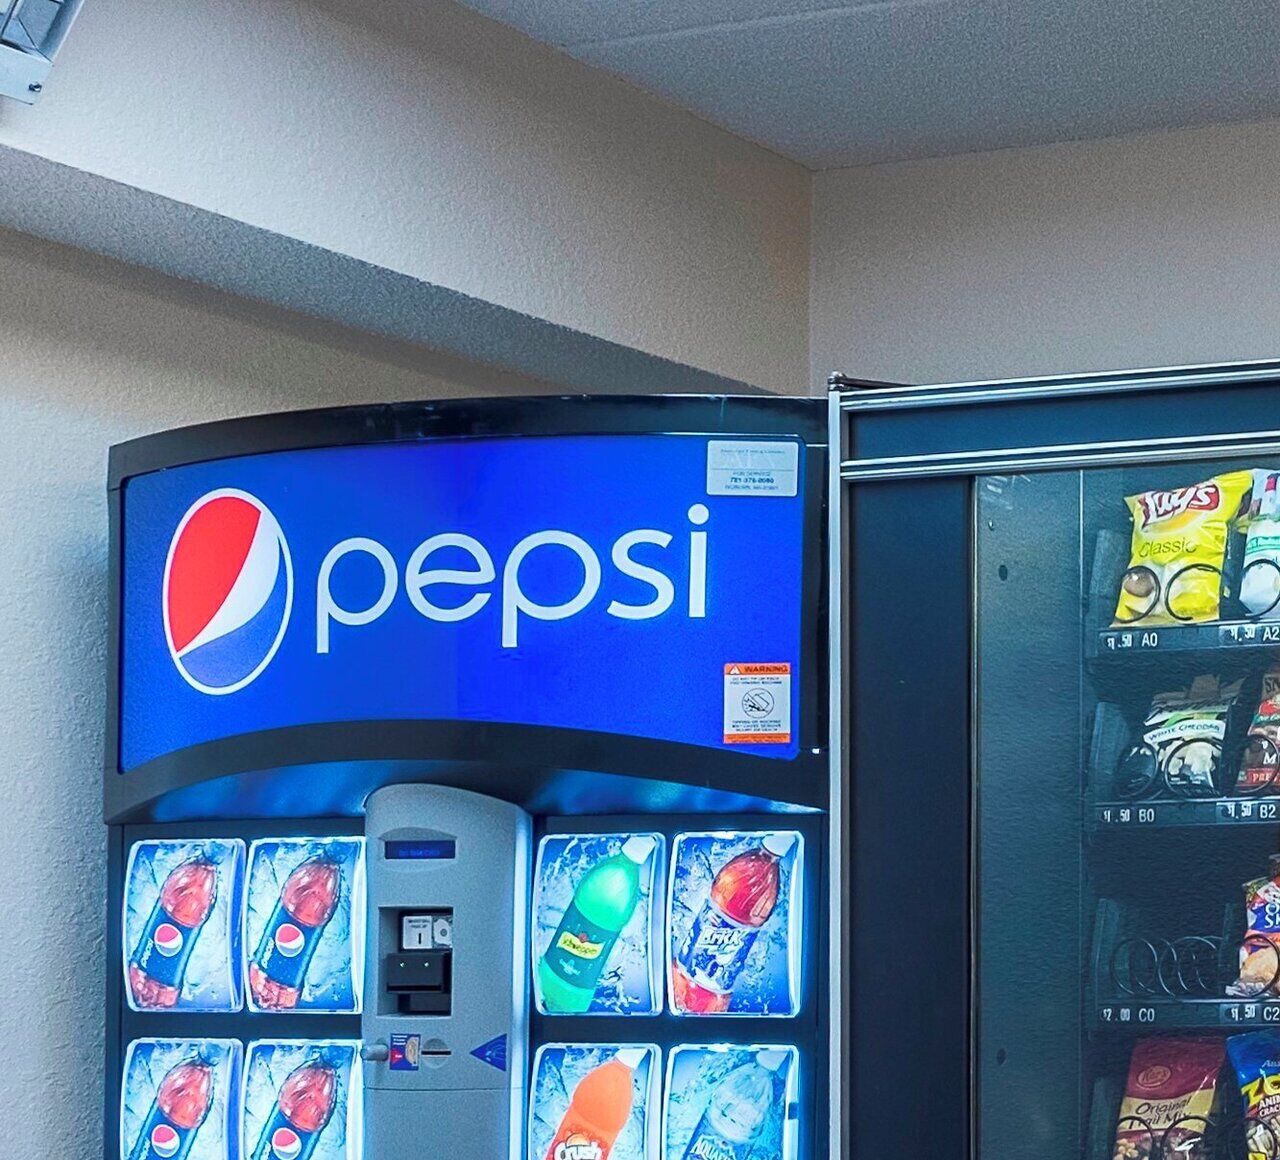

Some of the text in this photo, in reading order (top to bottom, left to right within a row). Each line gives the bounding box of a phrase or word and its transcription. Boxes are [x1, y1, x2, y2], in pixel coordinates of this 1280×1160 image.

[1139, 537, 1198, 558] Classic
[316, 503, 709, 654] pepsi
[1142, 633, 1158, 647] A0
[1263, 627, 1280, 642] A2
[744, 665, 788, 673] WARNING
[1138, 808, 1155, 822] B0
[1260, 804, 1276, 819] B2
[1138, 1008, 1155, 1022] C0
[1263, 1007, 1280, 1022] C2
[1136, 1095, 1192, 1114] Original
